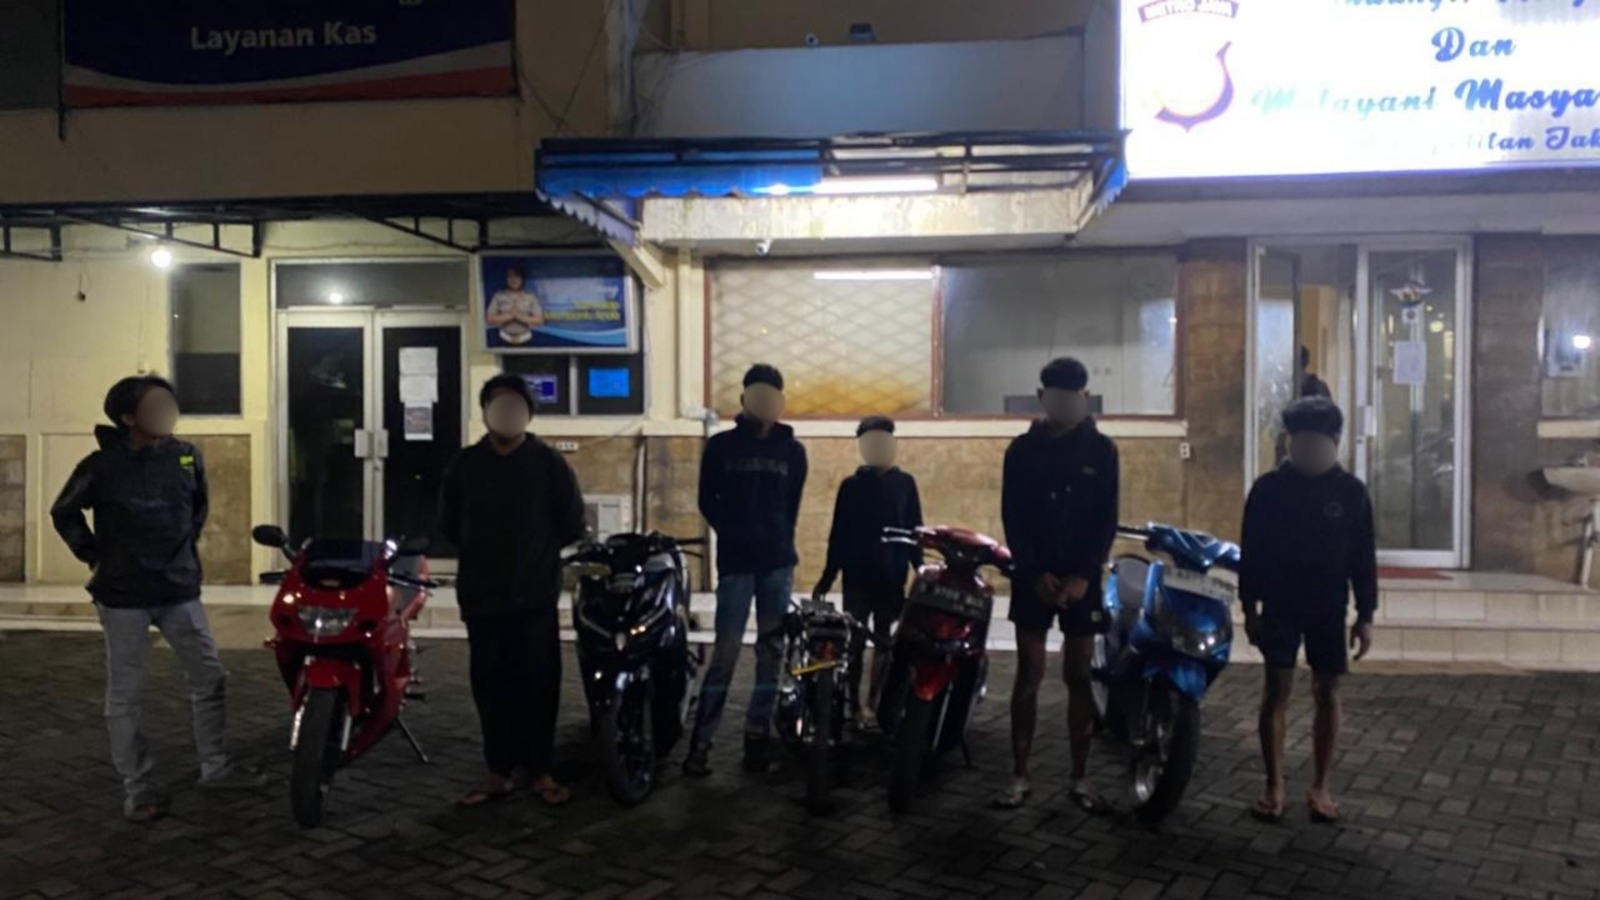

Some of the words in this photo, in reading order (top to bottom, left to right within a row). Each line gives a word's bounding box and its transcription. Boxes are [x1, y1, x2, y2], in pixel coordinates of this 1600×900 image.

[191, 26, 314, 56] Layanan
[323, 20, 377, 46] Kas
[1431, 26, 1515, 62] Dan
